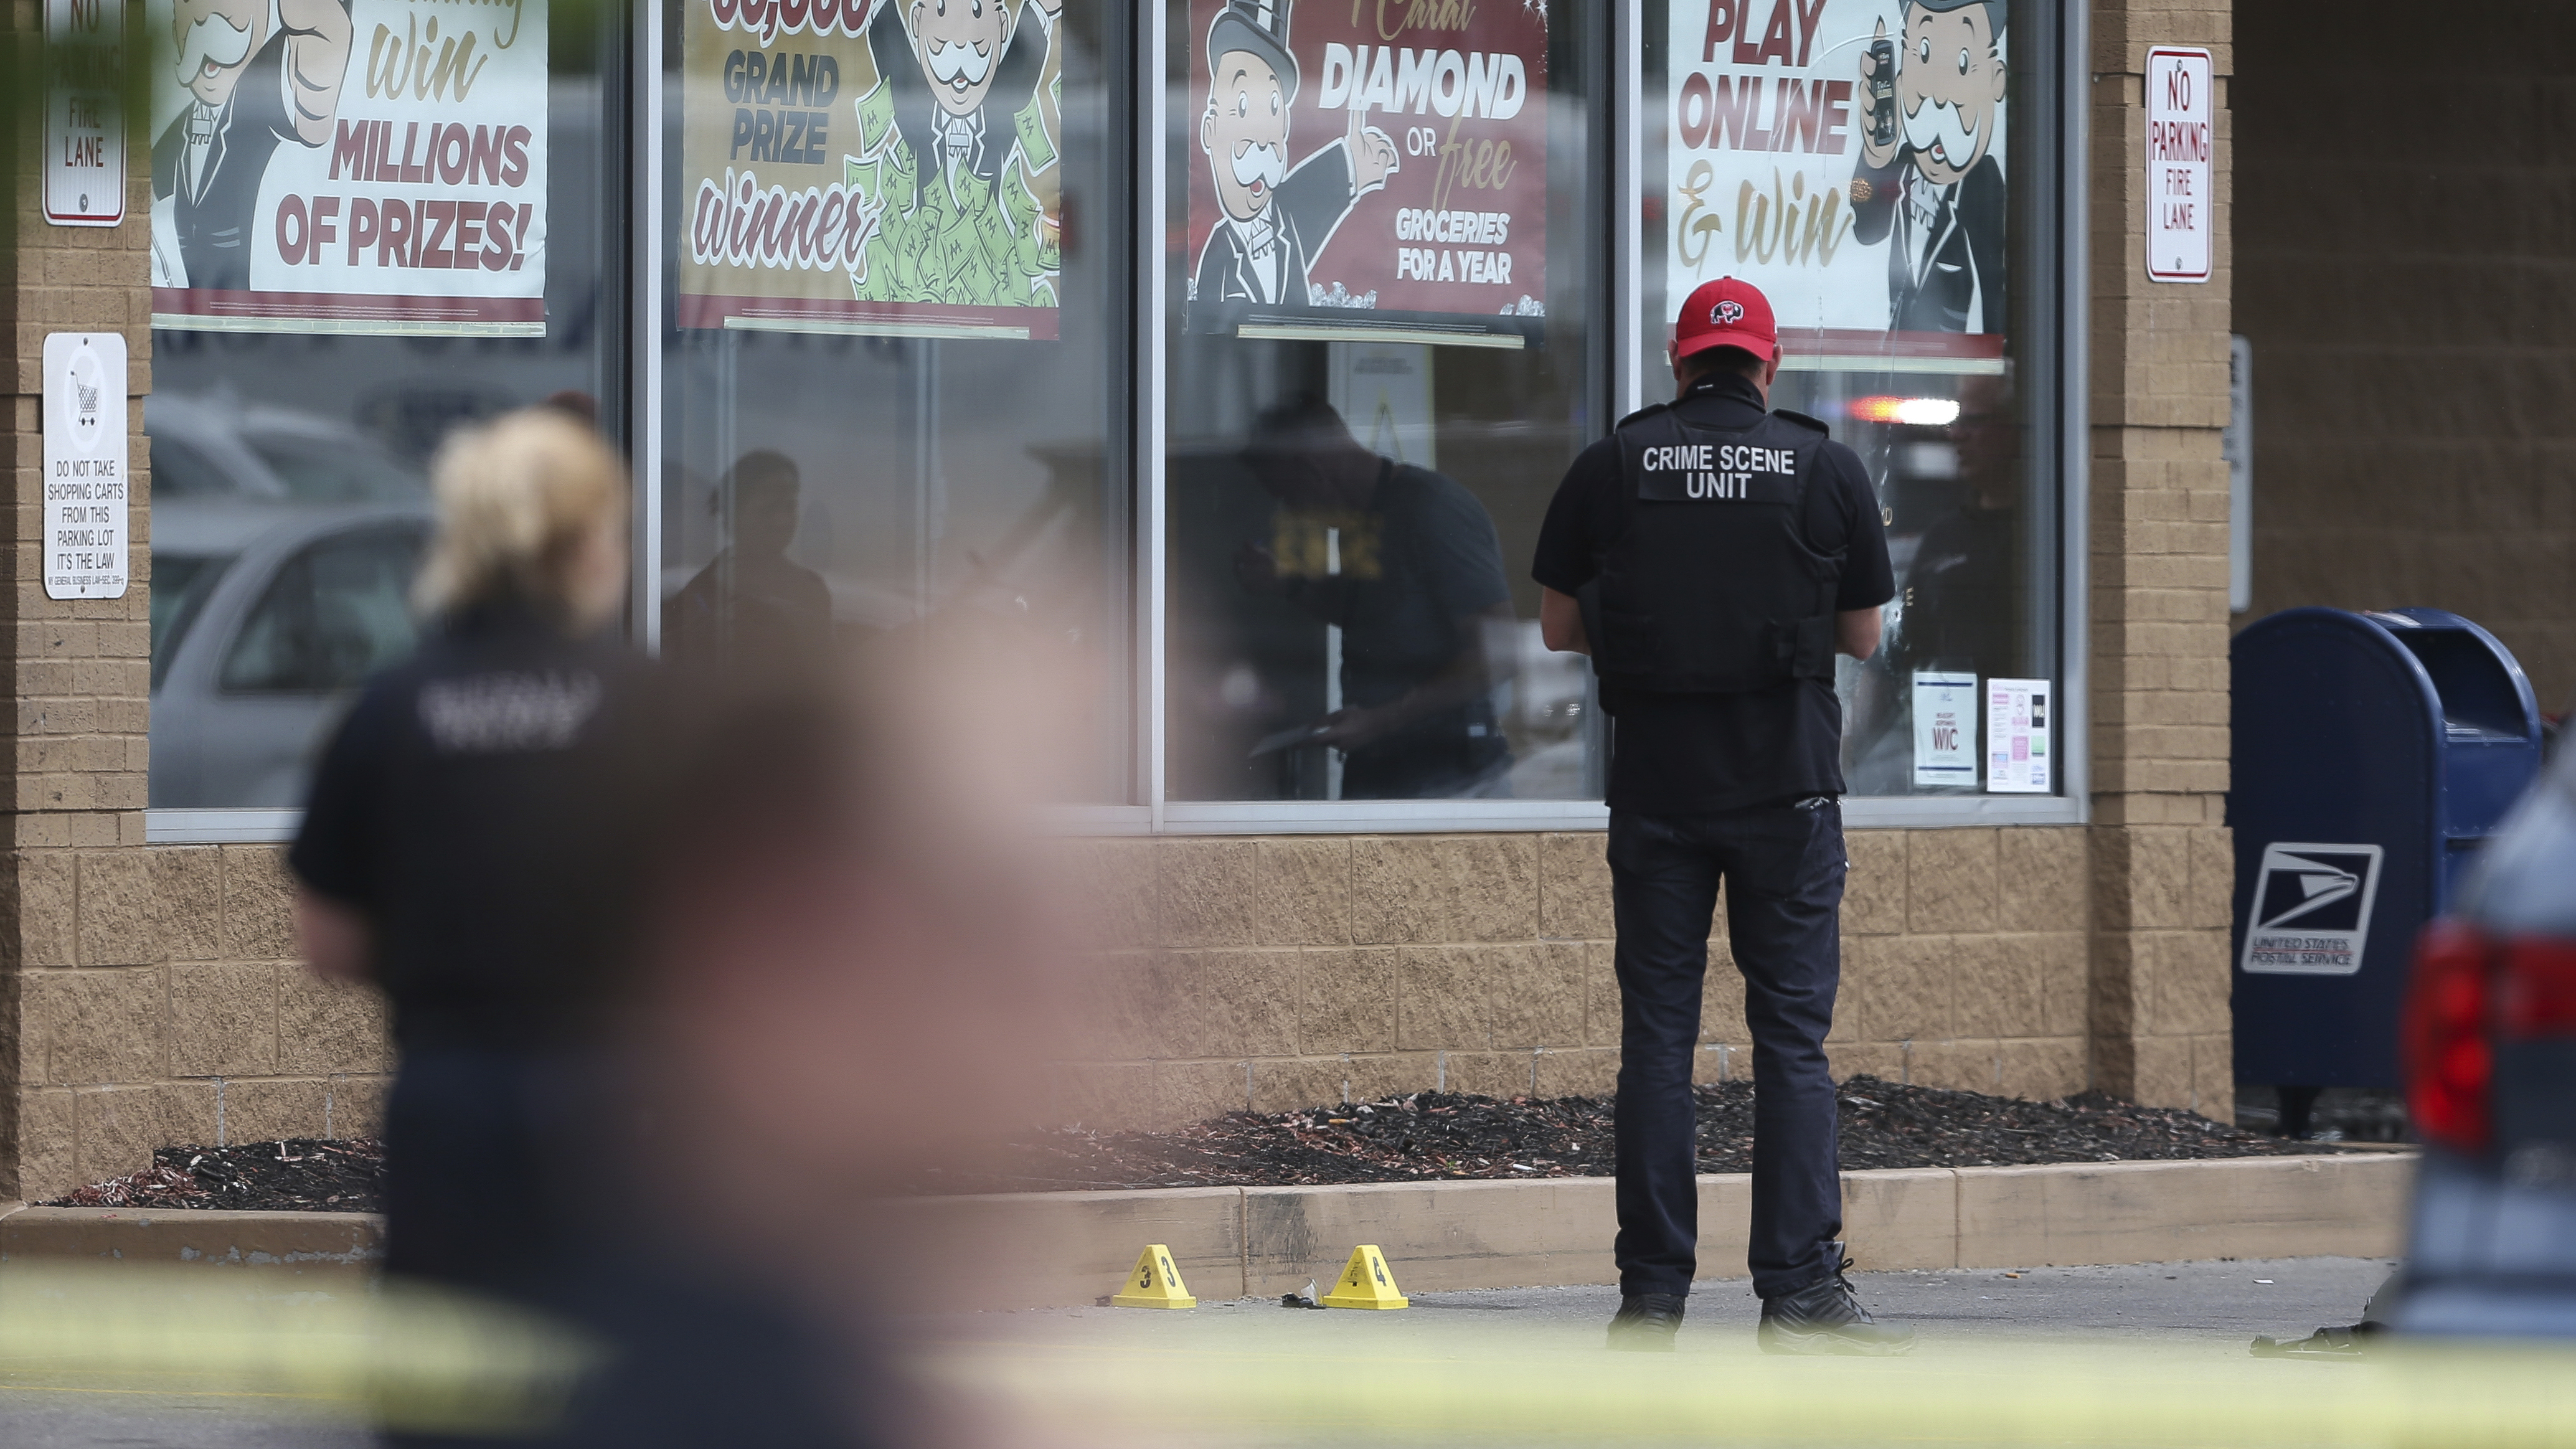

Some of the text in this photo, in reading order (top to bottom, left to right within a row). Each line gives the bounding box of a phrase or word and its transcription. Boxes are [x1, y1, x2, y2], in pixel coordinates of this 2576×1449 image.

[70, 0, 100, 31] NO
[1702, 0, 1829, 67] PLAY
[366, 10, 488, 103] Win
[723, 49, 839, 108] GRAND
[1318, 41, 1527, 120] DIAMOND
[2168, 70, 2191, 111] NO
[69, 97, 101, 128] FIRE
[1679, 72, 1854, 155] ONLINE
[65, 135, 104, 168] LANE
[729, 108, 829, 164] PRIZE
[1406, 126, 1437, 157] OR
[2152, 120, 2207, 163] PARKING
[328, 118, 532, 188] MILLIONS
[2166, 168, 2193, 196] FIRE
[1395, 207, 1511, 246] GROCERIES
[1734, 165, 1856, 268] Win
[2163, 202, 2195, 230] LANE
[275, 193, 534, 272] OF PRIZES!
[1396, 247, 1513, 285] FOR A YEAR
[56, 460, 115, 477] DO NOT TAKE
[1643, 445, 1795, 475] CRIME SCENE
[48, 483, 125, 500] SHOPPING CARTS
[1686, 472, 1753, 499] UNIT
[62, 506, 110, 524] FROM THIS
[57, 529, 115, 547] PARKING LOT
[75, 552, 93, 570] THE
[95, 552, 115, 570] LAW
[1933, 727, 1958, 750] WIC
[2251, 952, 2352, 965] POSTAL SERVICE
[2253, 936, 2350, 950] UNITED STATES
[1161, 1255, 1177, 1287] 3
[1372, 1256, 1387, 1287] 4
